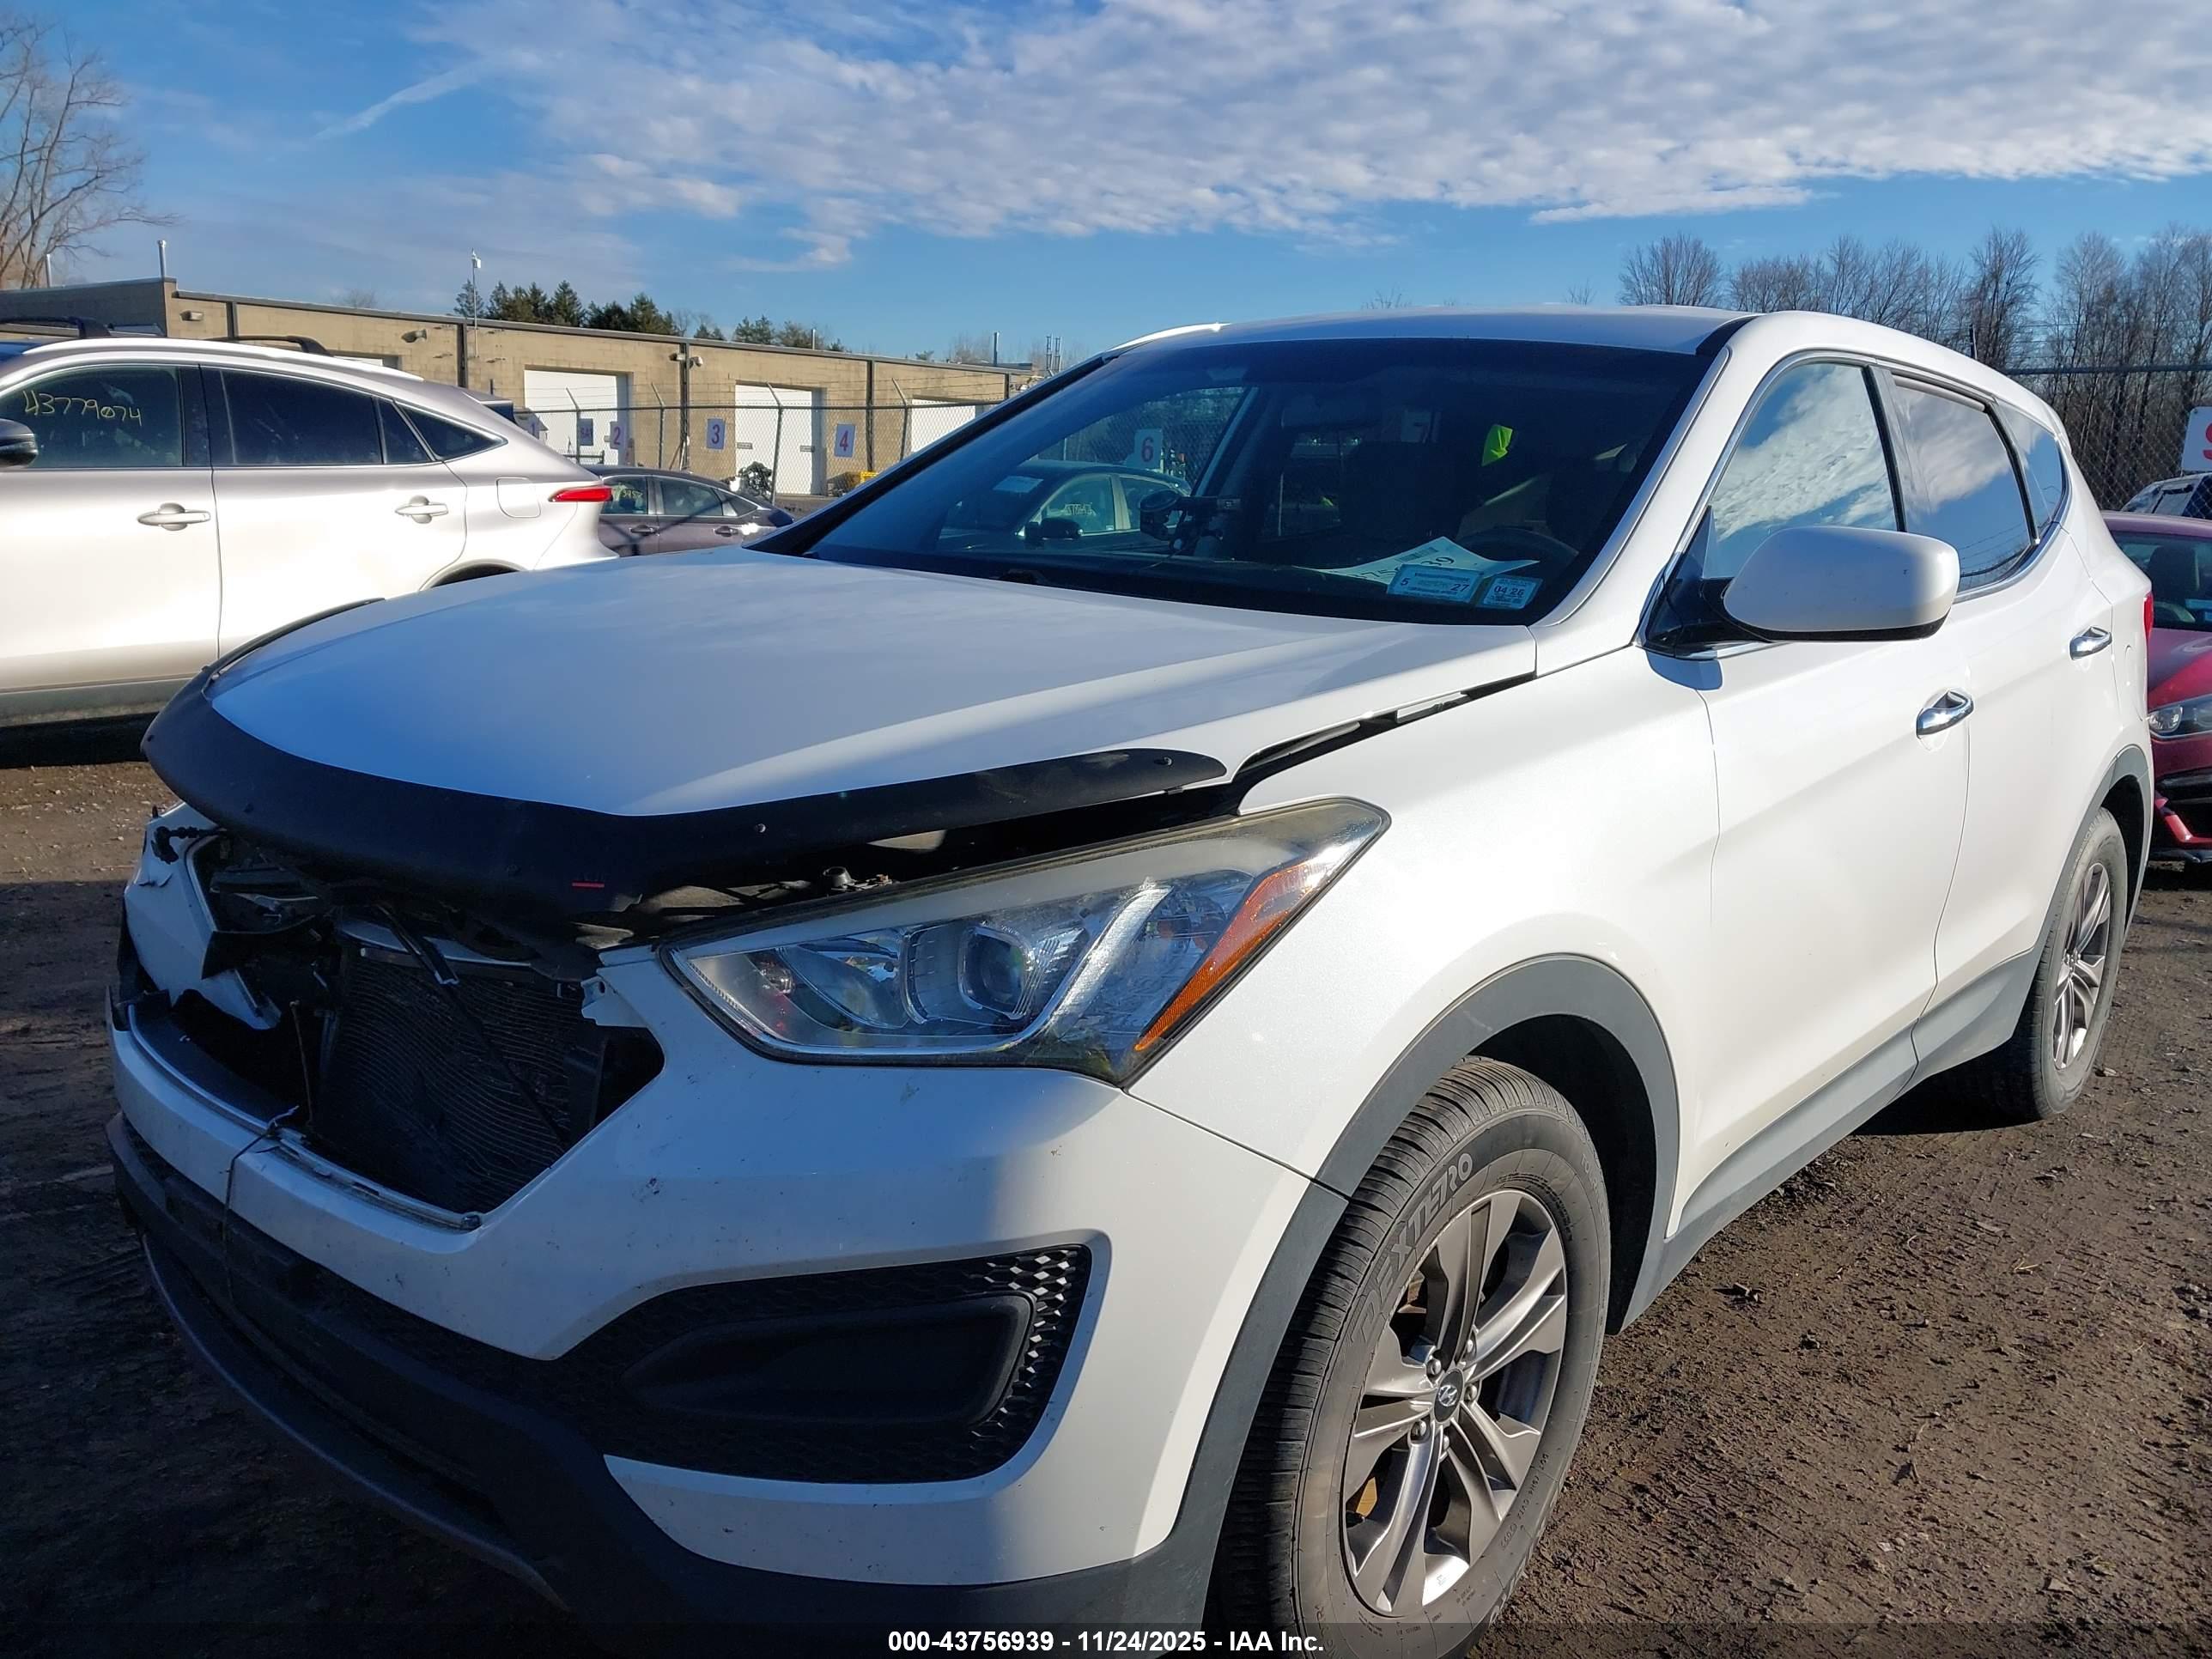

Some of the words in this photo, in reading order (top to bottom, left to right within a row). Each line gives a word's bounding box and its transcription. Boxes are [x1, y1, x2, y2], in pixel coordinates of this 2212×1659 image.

[22, 389, 143, 427] 43779074
[613, 426, 622, 446] 2
[711, 423, 720, 445] 3
[839, 430, 849, 452] 4
[1141, 436, 1154, 463] 6
[1401, 578, 1411, 586] 5
[1449, 584, 1470, 592] 27
